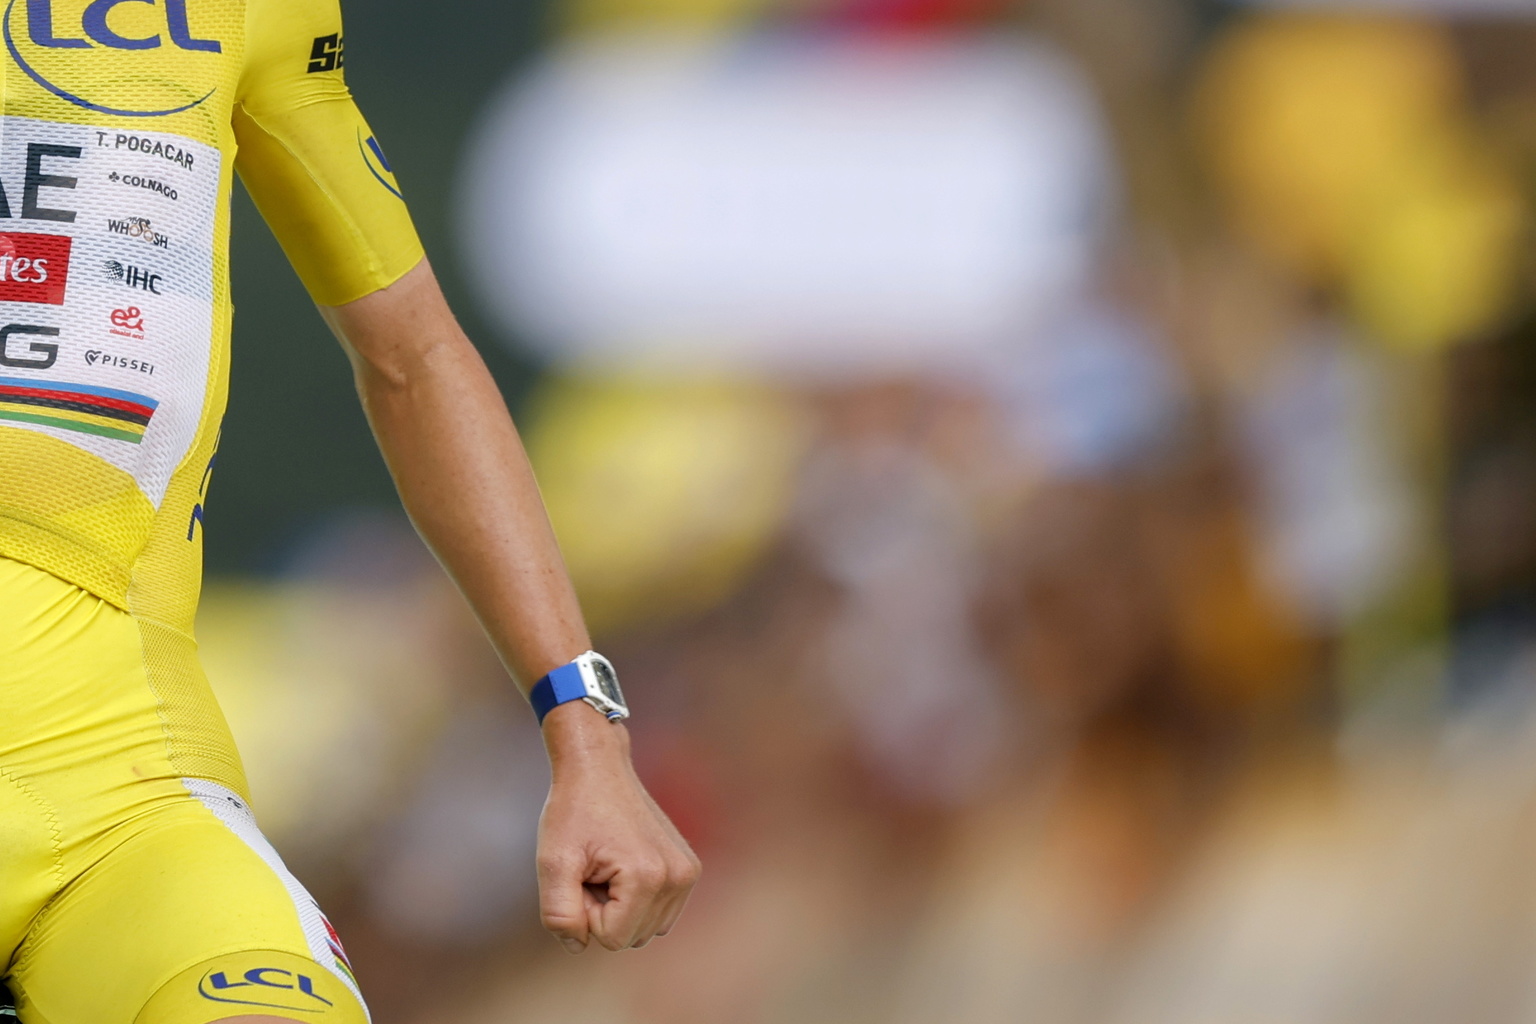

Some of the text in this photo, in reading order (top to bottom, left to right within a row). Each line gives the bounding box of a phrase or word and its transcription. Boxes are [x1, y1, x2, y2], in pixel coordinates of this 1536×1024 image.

[96, 131, 194, 171] T. POGACAR
[122, 175, 178, 200] COLNAGO
[126, 265, 163, 296] IHC
[101, 354, 155, 376] PISSEI
[209, 967, 334, 1007] LCL
